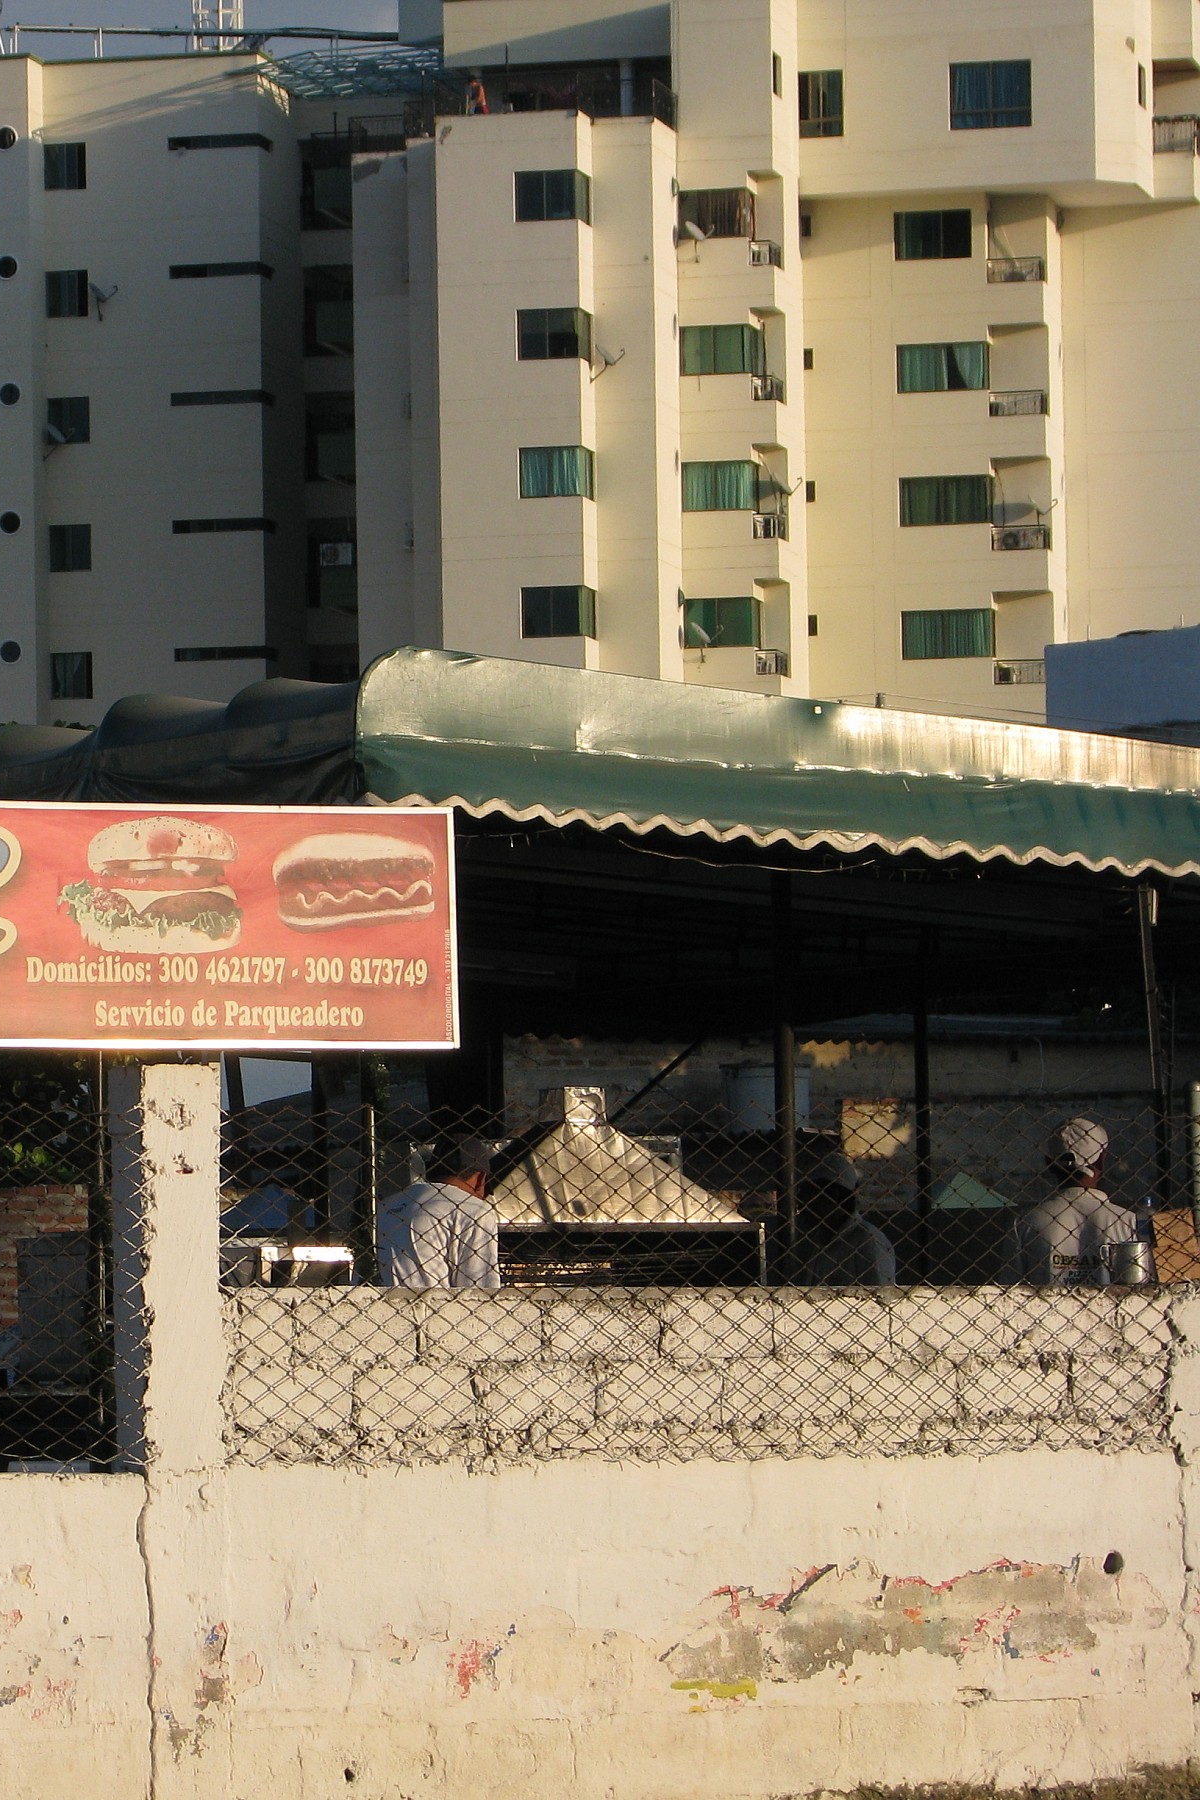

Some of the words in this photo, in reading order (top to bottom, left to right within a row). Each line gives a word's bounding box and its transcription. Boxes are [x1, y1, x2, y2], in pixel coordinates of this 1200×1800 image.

[26, 955, 152, 983] Domicilios:
[158, 956, 199, 983] 300
[205, 956, 286, 985] 4621797
[304, 957, 344, 984] 300
[350, 957, 428, 987] 8173749
[95, 999, 185, 1027] Servicio
[191, 999, 218, 1027] de
[224, 1000, 364, 1034] Parqueadero
